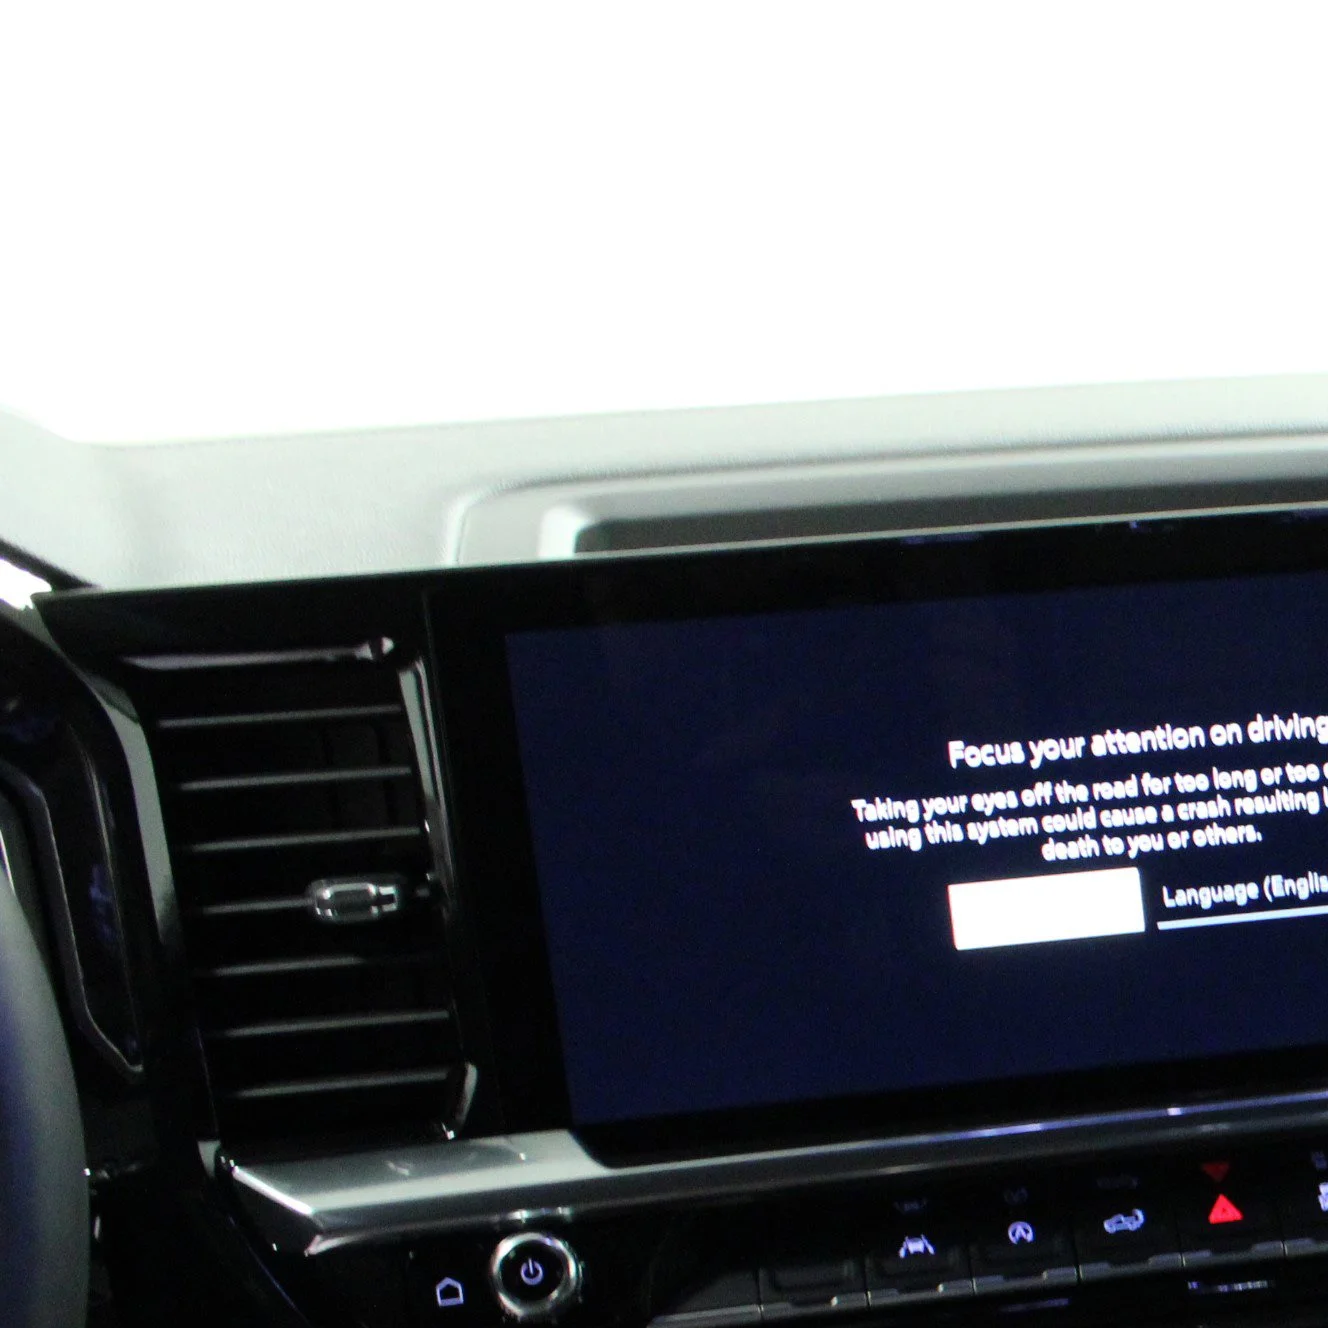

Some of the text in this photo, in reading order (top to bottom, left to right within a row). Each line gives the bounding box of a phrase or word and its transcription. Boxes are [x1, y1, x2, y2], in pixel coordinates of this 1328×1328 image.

[948, 740, 1025, 768] Focus
[1029, 736, 1085, 769] your
[1091, 723, 1205, 757] attention
[1210, 722, 1243, 746] on
[851, 797, 919, 823] Taking
[922, 795, 968, 820] your
[971, 790, 1018, 815] eyes
[1021, 780, 1053, 807] off
[1054, 780, 1089, 803] the
[1092, 774, 1138, 800] road
[1141, 772, 1171, 796] for
[1174, 772, 1209, 793] too
[1212, 767, 1257, 792] long
[1260, 765, 1283, 786] or
[1285, 762, 1320, 783] too
[865, 826, 922, 851] using
[924, 820, 964, 845] this
[967, 814, 1038, 845] system
[1042, 806, 1096, 833] could
[1099, 804, 1158, 829] cause
[1161, 804, 1174, 823] a
[1177, 795, 1231, 820] crash
[1234, 788, 1320, 815] resulting
[1041, 822, 1262, 861] death to you or others.
[1162, 881, 1258, 909] Language
